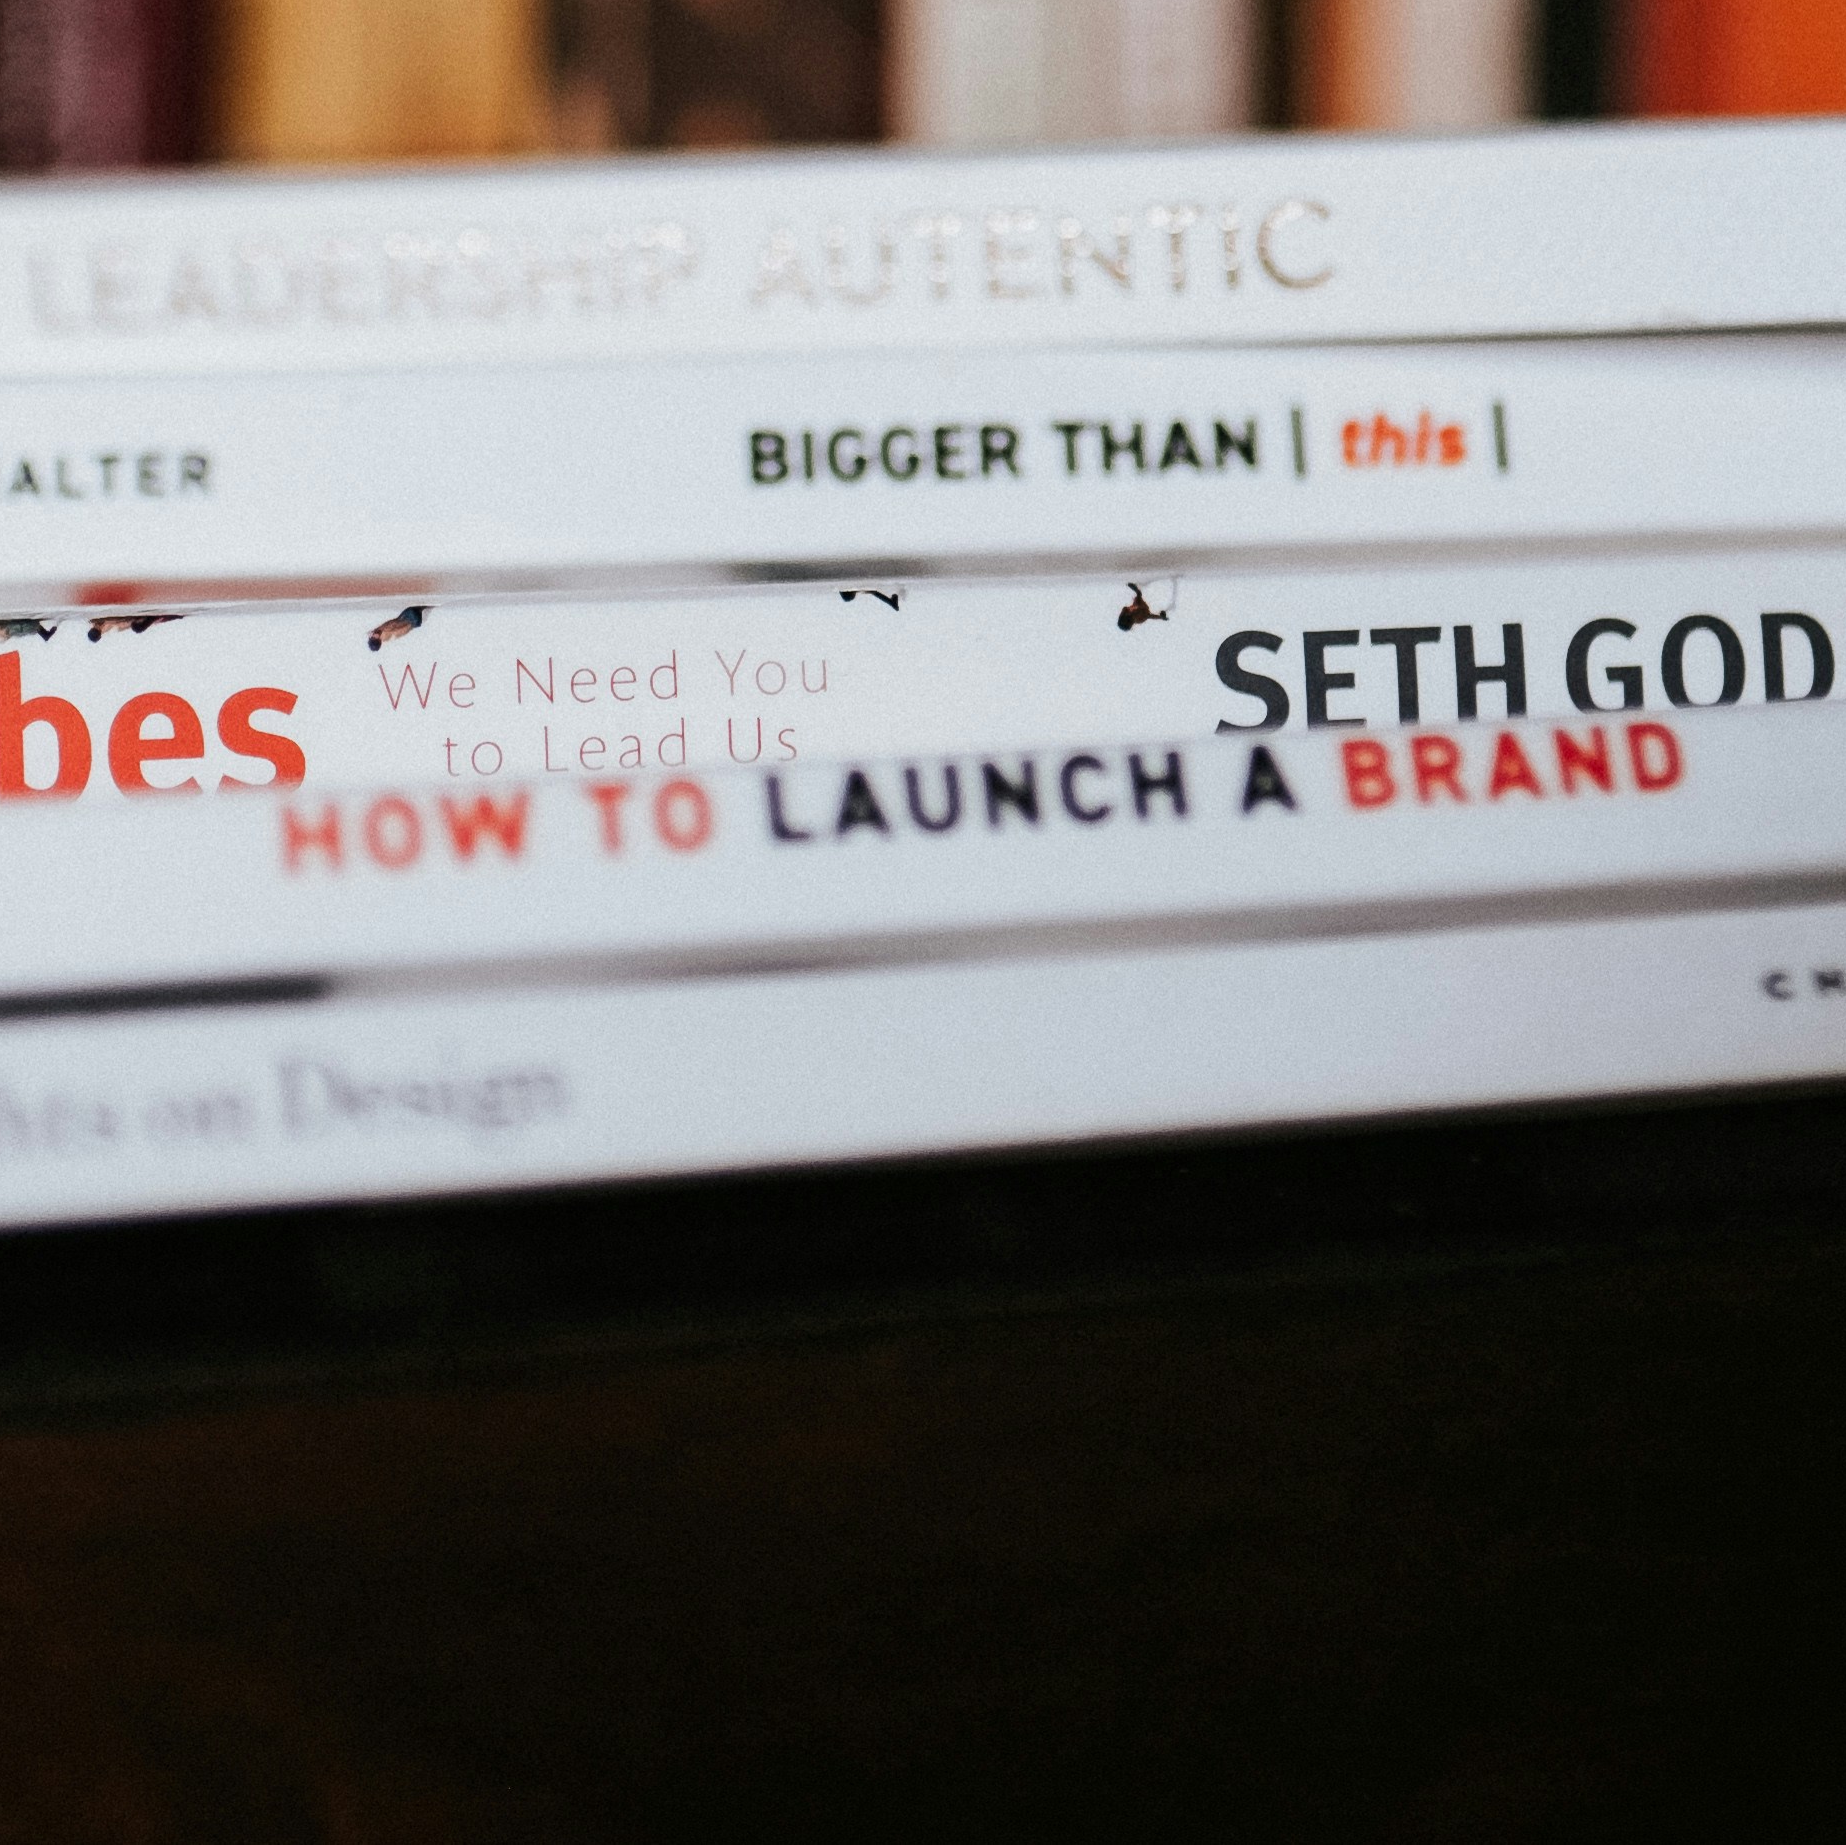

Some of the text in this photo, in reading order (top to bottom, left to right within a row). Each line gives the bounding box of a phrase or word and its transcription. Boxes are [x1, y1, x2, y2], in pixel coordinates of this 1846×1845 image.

[24, 200, 1335, 336] LEADERSHIP AUTENTIC
[749, 407, 1467, 485] BIGGER THAN this
[378, 645, 831, 713] We Need You
[1213, 622, 1526, 735] SETH
[442, 714, 800, 779] to Lead Us
[277, 719, 1687, 875] HOW TO LAUNCH A BRAND
